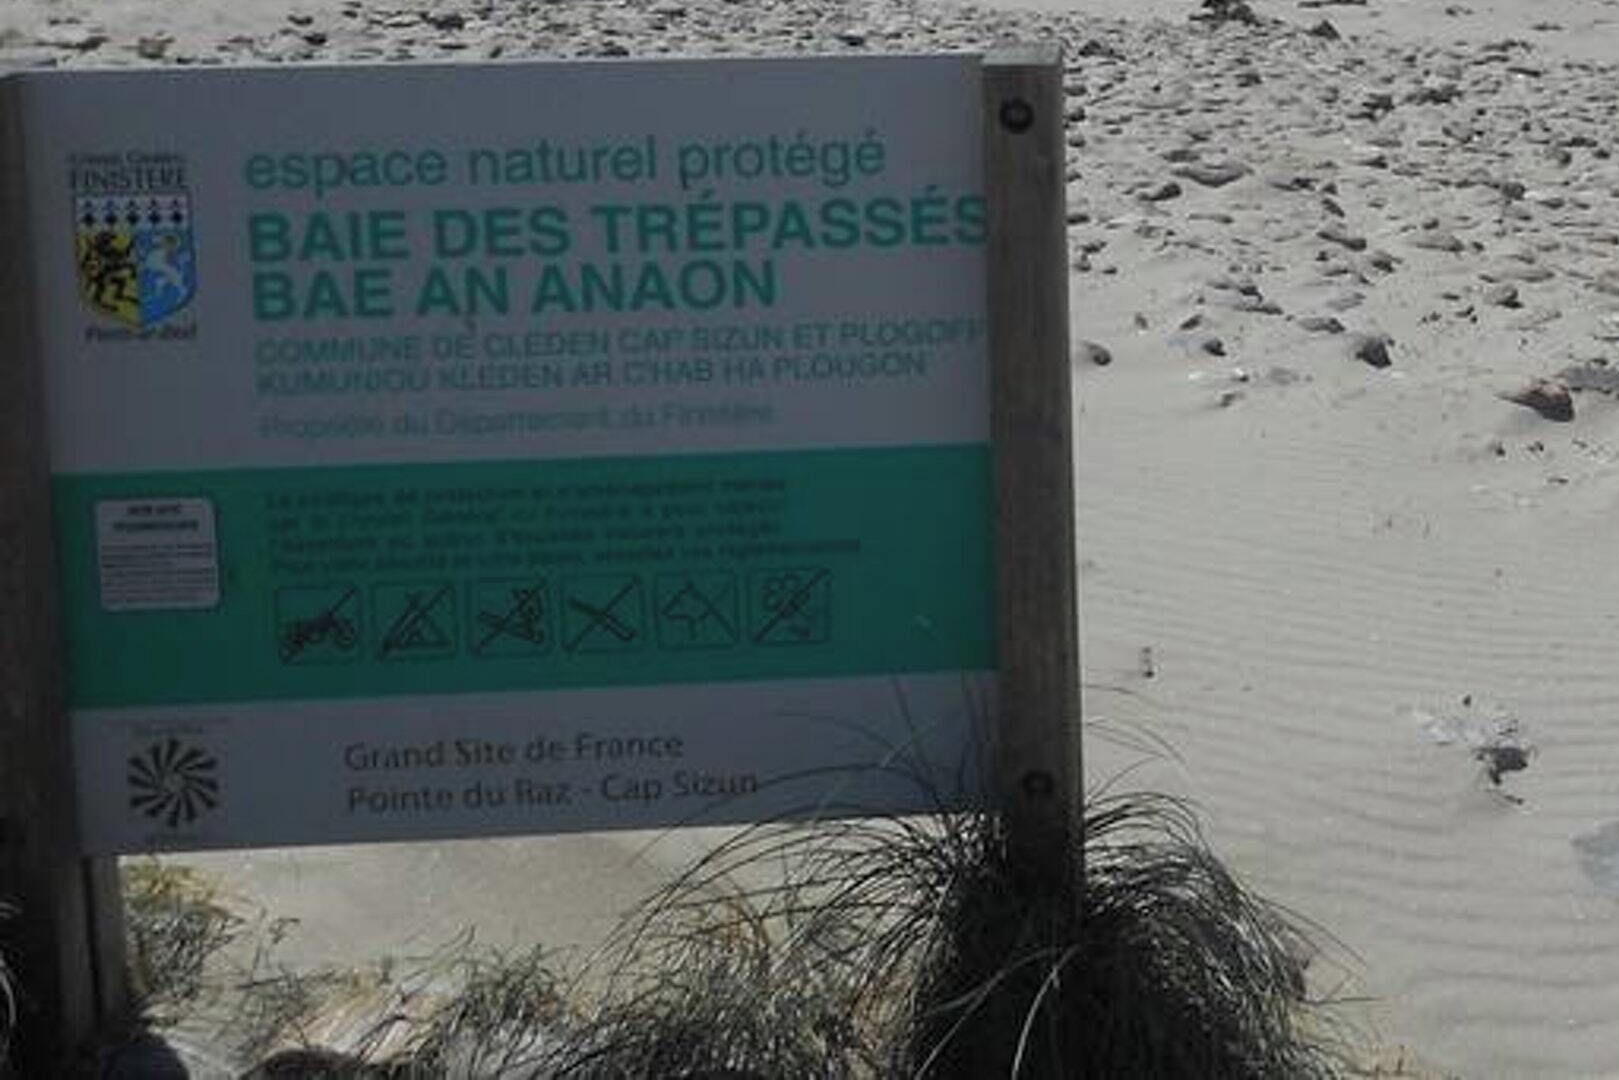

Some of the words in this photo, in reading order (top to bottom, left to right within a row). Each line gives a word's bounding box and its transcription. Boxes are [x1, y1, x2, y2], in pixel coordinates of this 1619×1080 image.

[246, 150, 447, 198] espace
[468, 132, 657, 186] naturel
[677, 127, 886, 190] protégé
[248, 210, 411, 262] BAIE
[433, 204, 571, 259] DES
[591, 183, 988, 254] TRÉPASSÉS
[252, 268, 397, 322] BAE
[415, 265, 510, 318] AN
[530, 257, 777, 313] ANAON
[254, 334, 423, 366] COMMUNE
[431, 332, 476, 361] DE
[617, 325, 685, 353] CAP
[691, 321, 784, 352] SIZUN
[792, 322, 832, 350] ET
[437, 364, 565, 392] KLEDEN
[571, 361, 613, 388] AR
[722, 355, 767, 384] HA
[343, 740, 447, 771] Grand
[454, 736, 517, 768] Site
[524, 734, 569, 764] de
[573, 732, 685, 761] France
[347, 781, 455, 814] Pointe
[463, 780, 507, 810] du
[513, 776, 574, 807] Raz
[599, 772, 665, 806] Cap
[672, 768, 760, 799] Sizun
